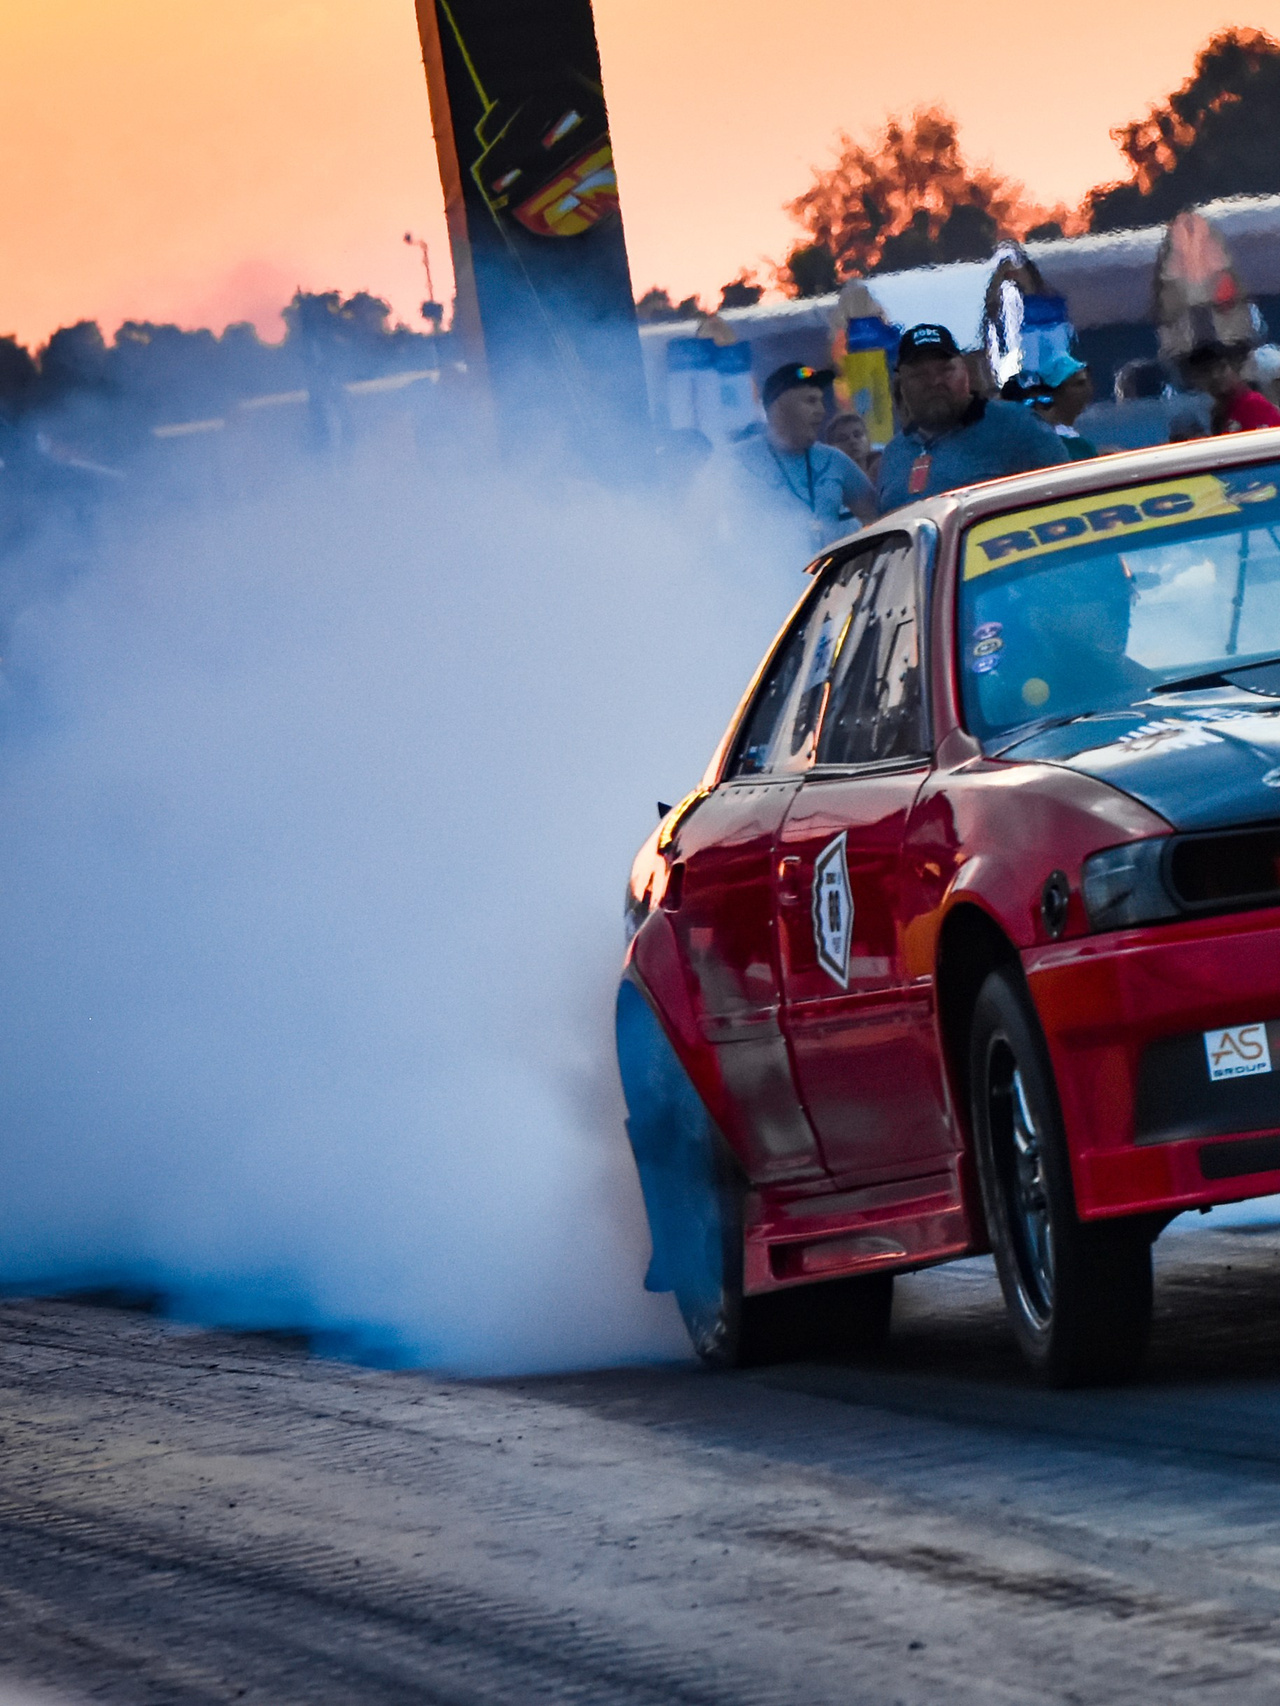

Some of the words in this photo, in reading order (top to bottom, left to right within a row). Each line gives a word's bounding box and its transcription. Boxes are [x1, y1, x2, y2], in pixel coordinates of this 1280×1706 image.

[976, 492, 1195, 561] RDRC
[1211, 1026, 1264, 1066] AS
[1213, 1062, 1267, 1077] GROUP
